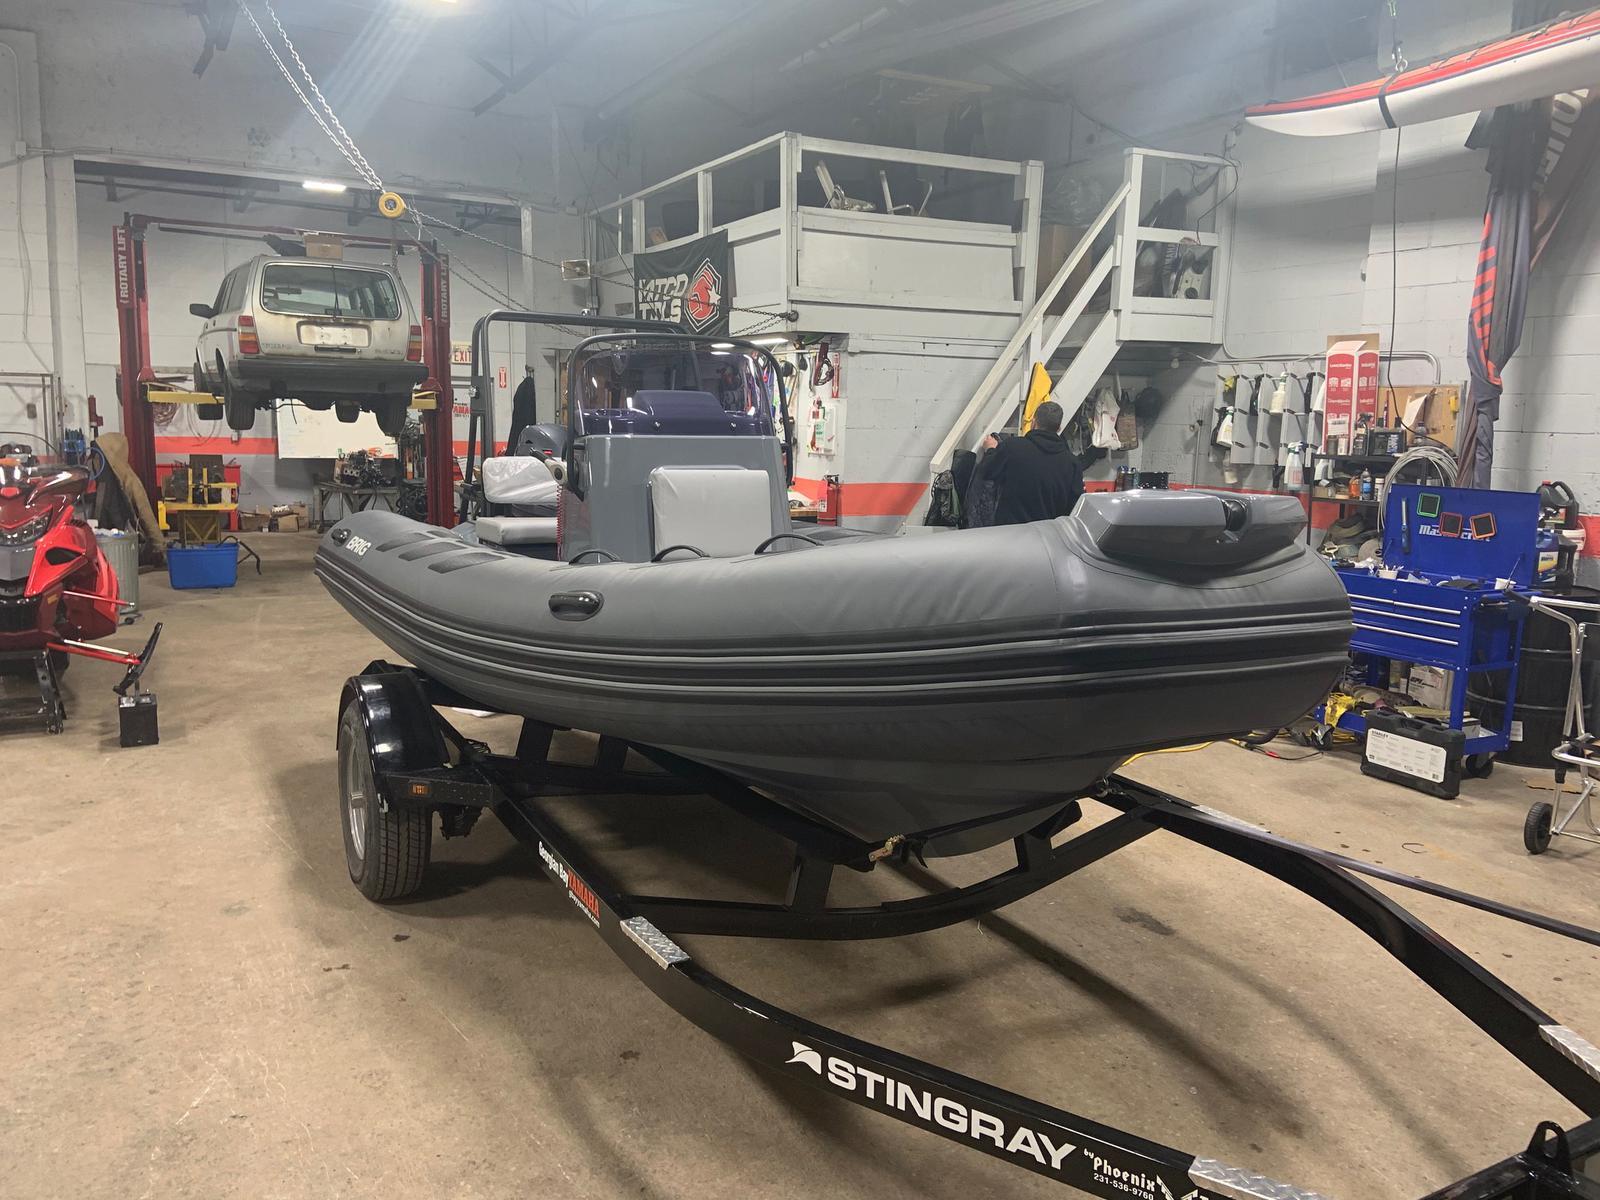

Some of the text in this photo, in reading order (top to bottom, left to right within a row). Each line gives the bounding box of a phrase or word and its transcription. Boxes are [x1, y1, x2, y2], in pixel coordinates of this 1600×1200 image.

[118, 253, 129, 298] ROTARY
[454, 350, 472, 362] EXIT
[346, 535, 372, 556] BRIG
[567, 868, 600, 919] YAMAHA
[827, 1056, 1157, 1193] STINGRAY by Phoenix
[1093, 1172, 1155, 1200] 231-536-9760
